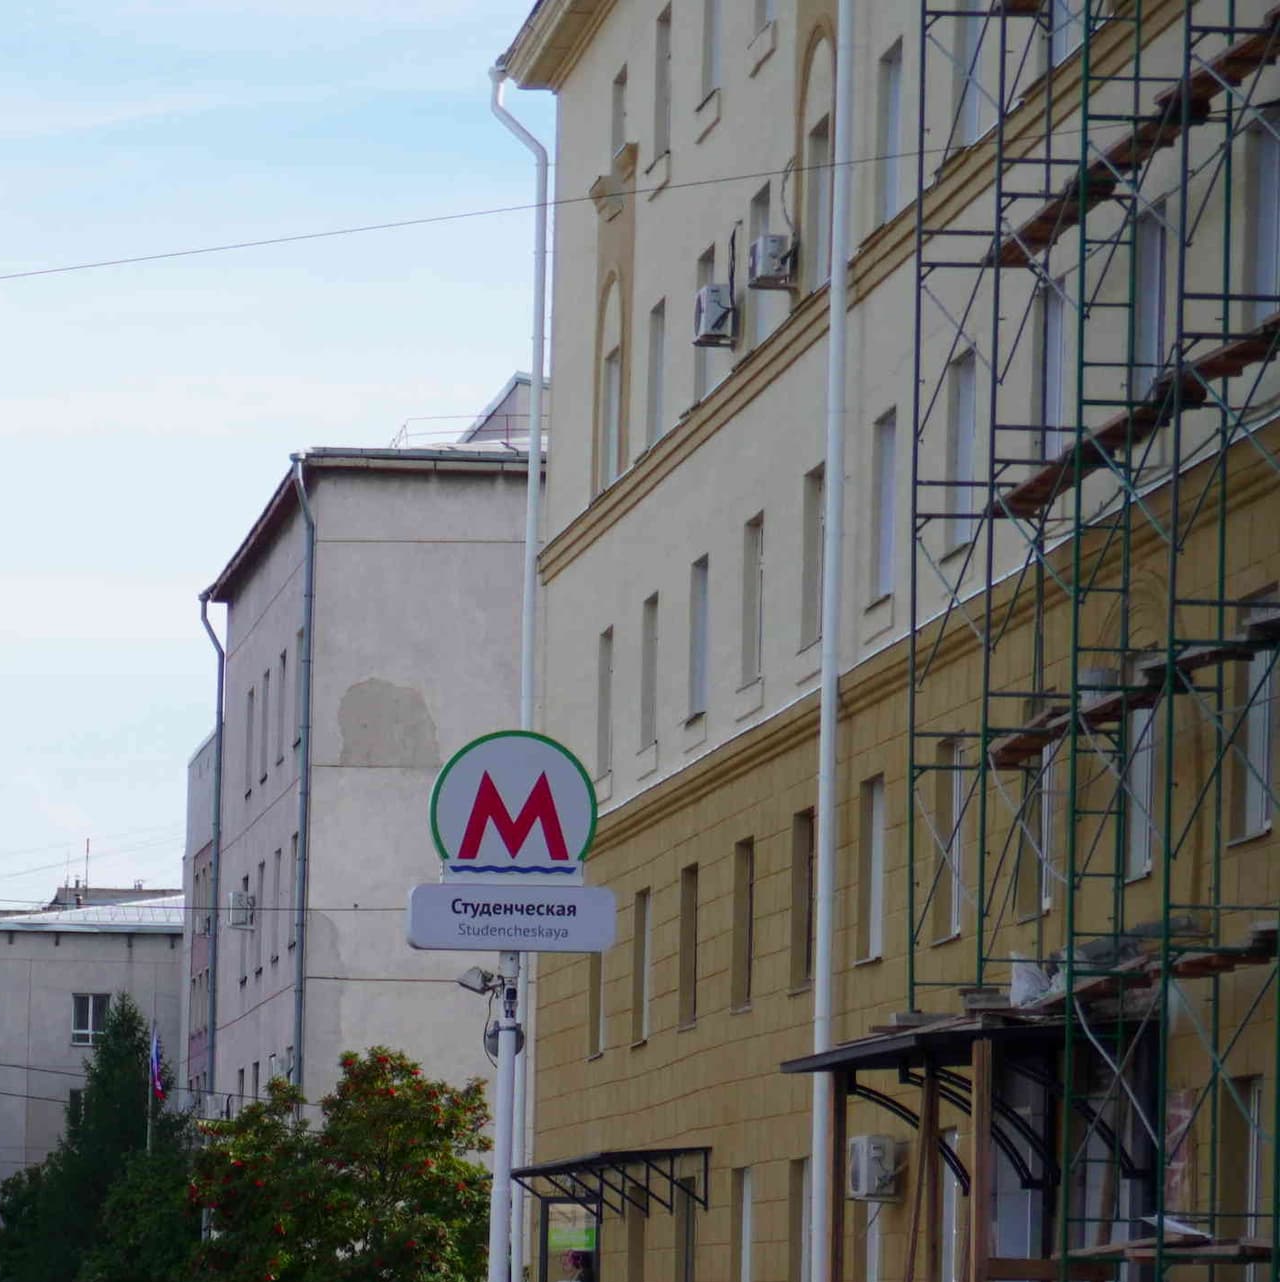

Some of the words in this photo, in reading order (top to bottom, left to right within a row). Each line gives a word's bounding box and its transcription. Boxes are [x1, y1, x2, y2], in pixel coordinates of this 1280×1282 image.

[457, 770, 569, 860] М
[451, 898, 577, 919] Студенческая
[457, 923, 569, 939] Studencheskaya
